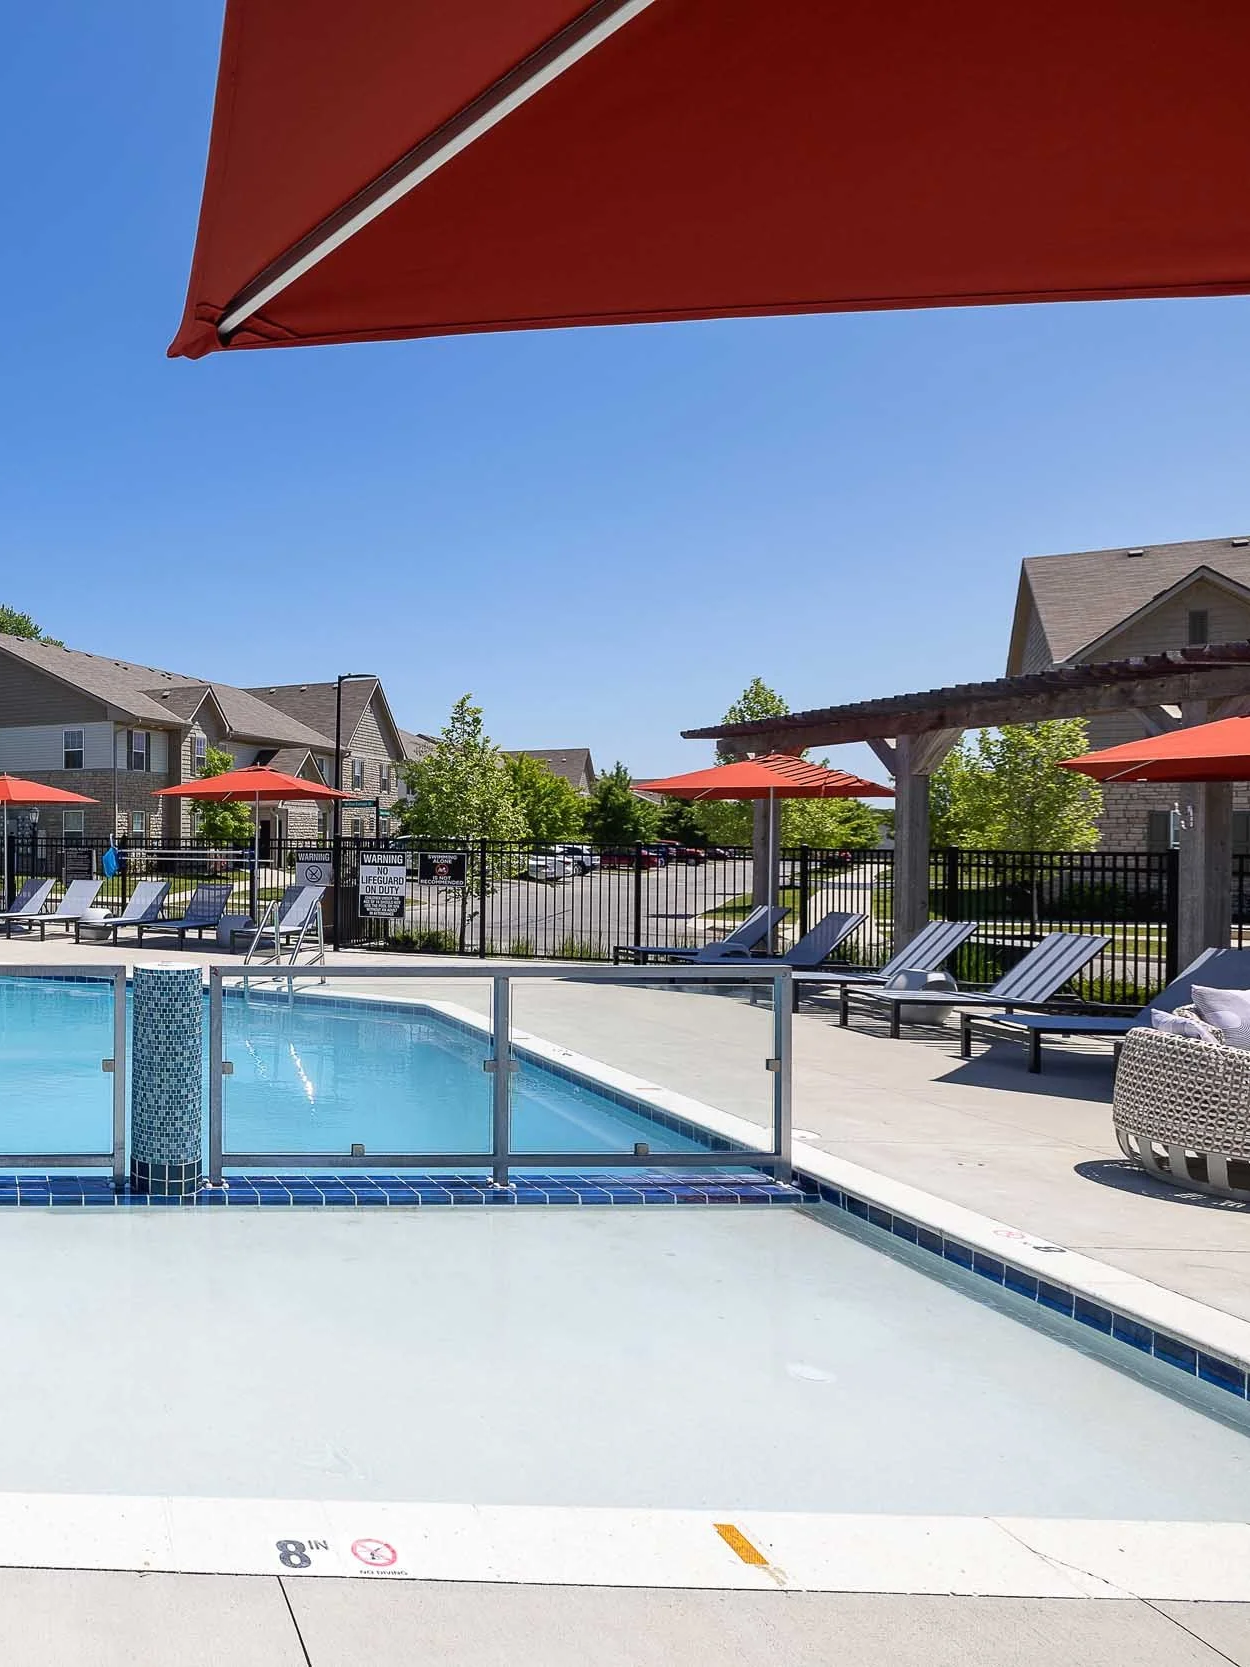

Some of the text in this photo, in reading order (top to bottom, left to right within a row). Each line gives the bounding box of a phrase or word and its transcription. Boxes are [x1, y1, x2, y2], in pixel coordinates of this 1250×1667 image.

[298, 852, 330, 862] WARNING
[363, 854, 403, 864] WARNING
[377, 866, 389, 875] NO
[361, 875, 404, 885] LIFEGUARD
[365, 885, 400, 895] ON DUTY
[276, 1540, 329, 1568] 8 IN
